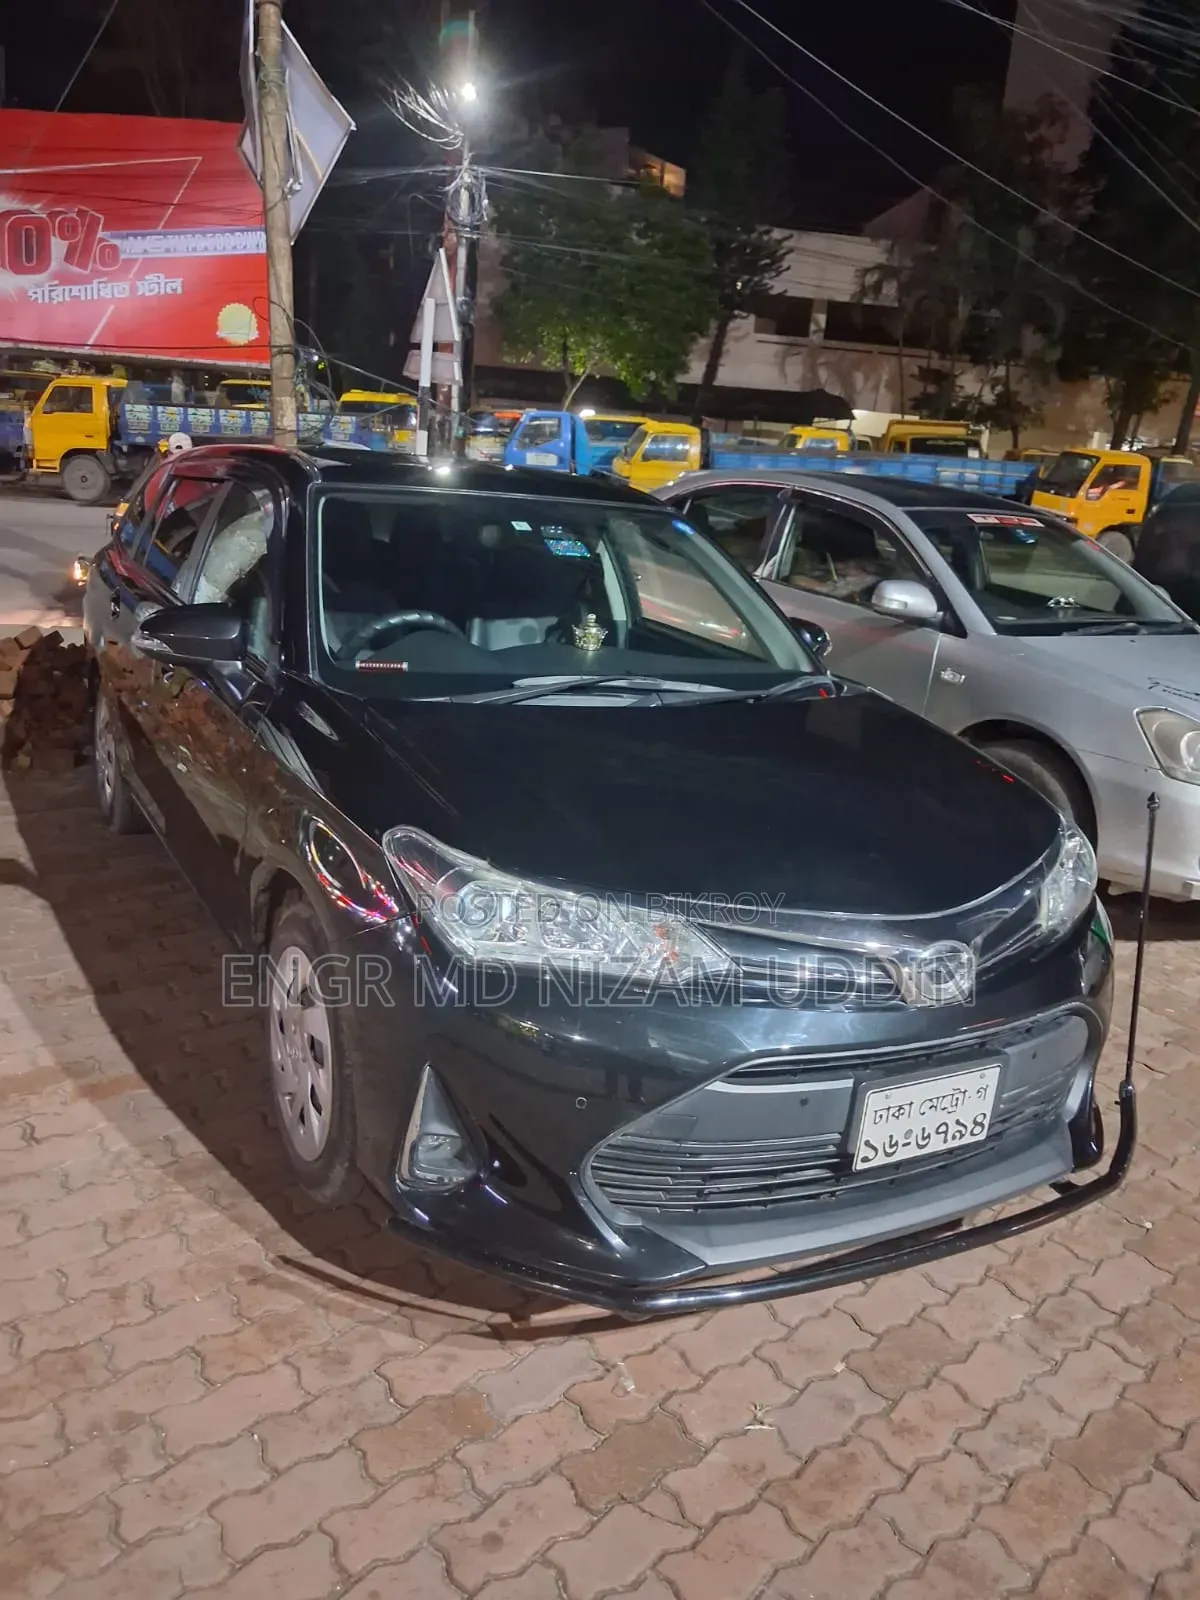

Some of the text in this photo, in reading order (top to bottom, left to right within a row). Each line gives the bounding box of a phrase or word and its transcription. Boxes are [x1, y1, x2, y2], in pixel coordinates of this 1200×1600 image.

[27, 272, 184, 304] পরিশোধিত স্টীল
[873, 1101, 914, 1125] ঢাকা
[860, 1112, 987, 1163] ১৬-৬৭৯৪
